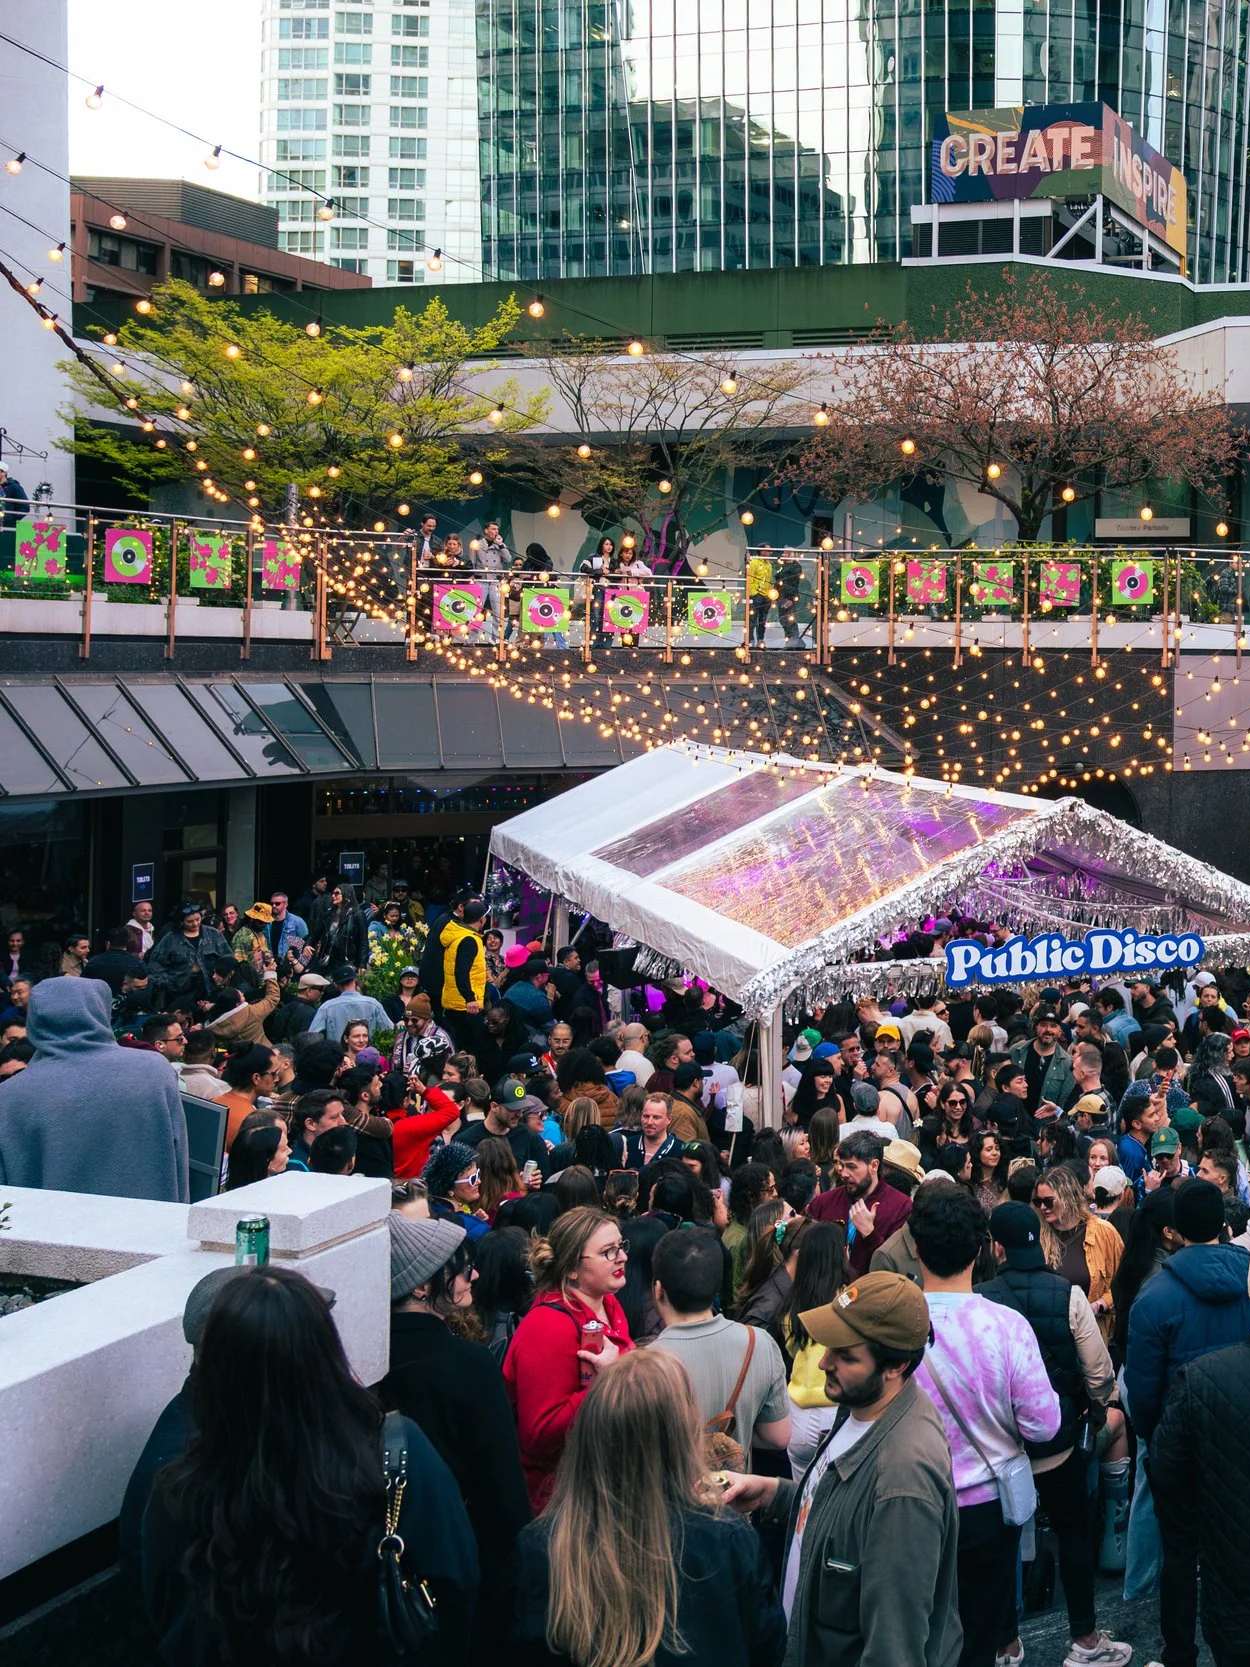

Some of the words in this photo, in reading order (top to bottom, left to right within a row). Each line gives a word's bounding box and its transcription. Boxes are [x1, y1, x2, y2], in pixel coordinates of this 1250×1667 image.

[940, 126, 1095, 178] CREATE
[1113, 136, 1177, 226] INSPIRE
[951, 938, 1086, 982] Public
[1089, 932, 1200, 969] Disco
